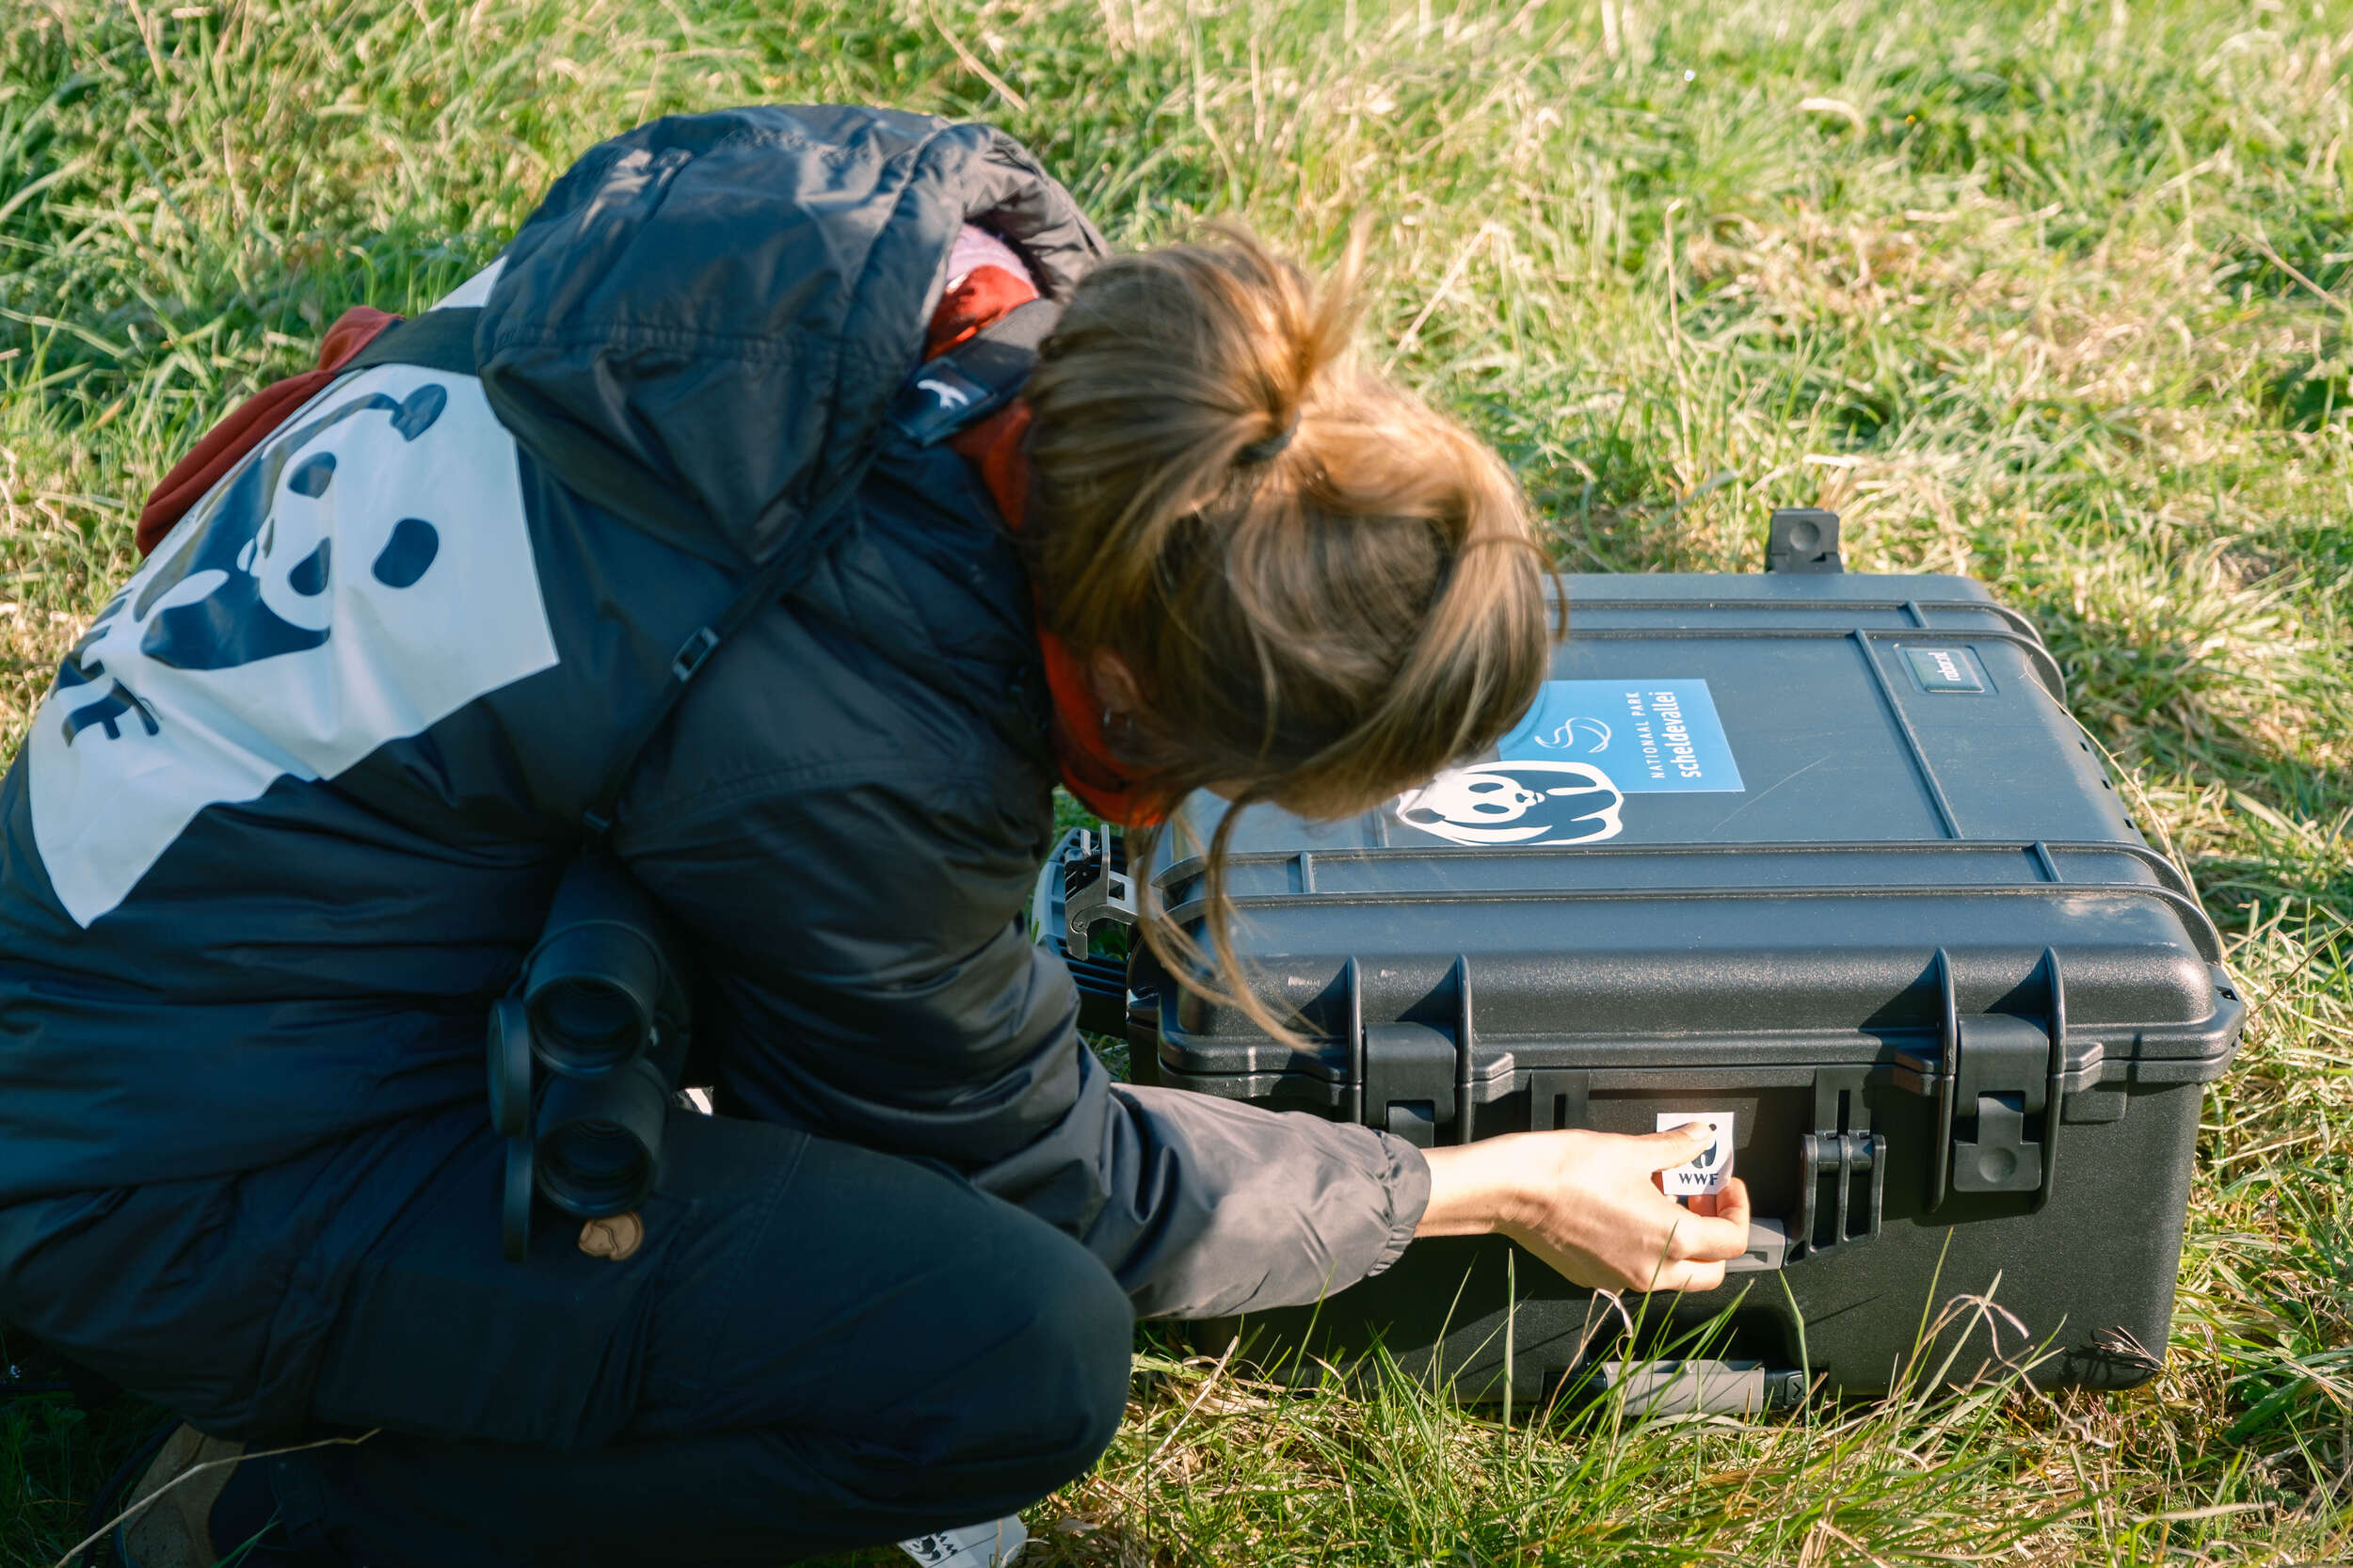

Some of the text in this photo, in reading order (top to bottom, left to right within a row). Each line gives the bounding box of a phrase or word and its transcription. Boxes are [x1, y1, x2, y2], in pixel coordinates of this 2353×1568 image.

[1625, 692, 1666, 778] NATIONAAL PARK
[1648, 691, 1702, 778] scheldevallei
[1678, 1173, 1719, 1186] WWF
